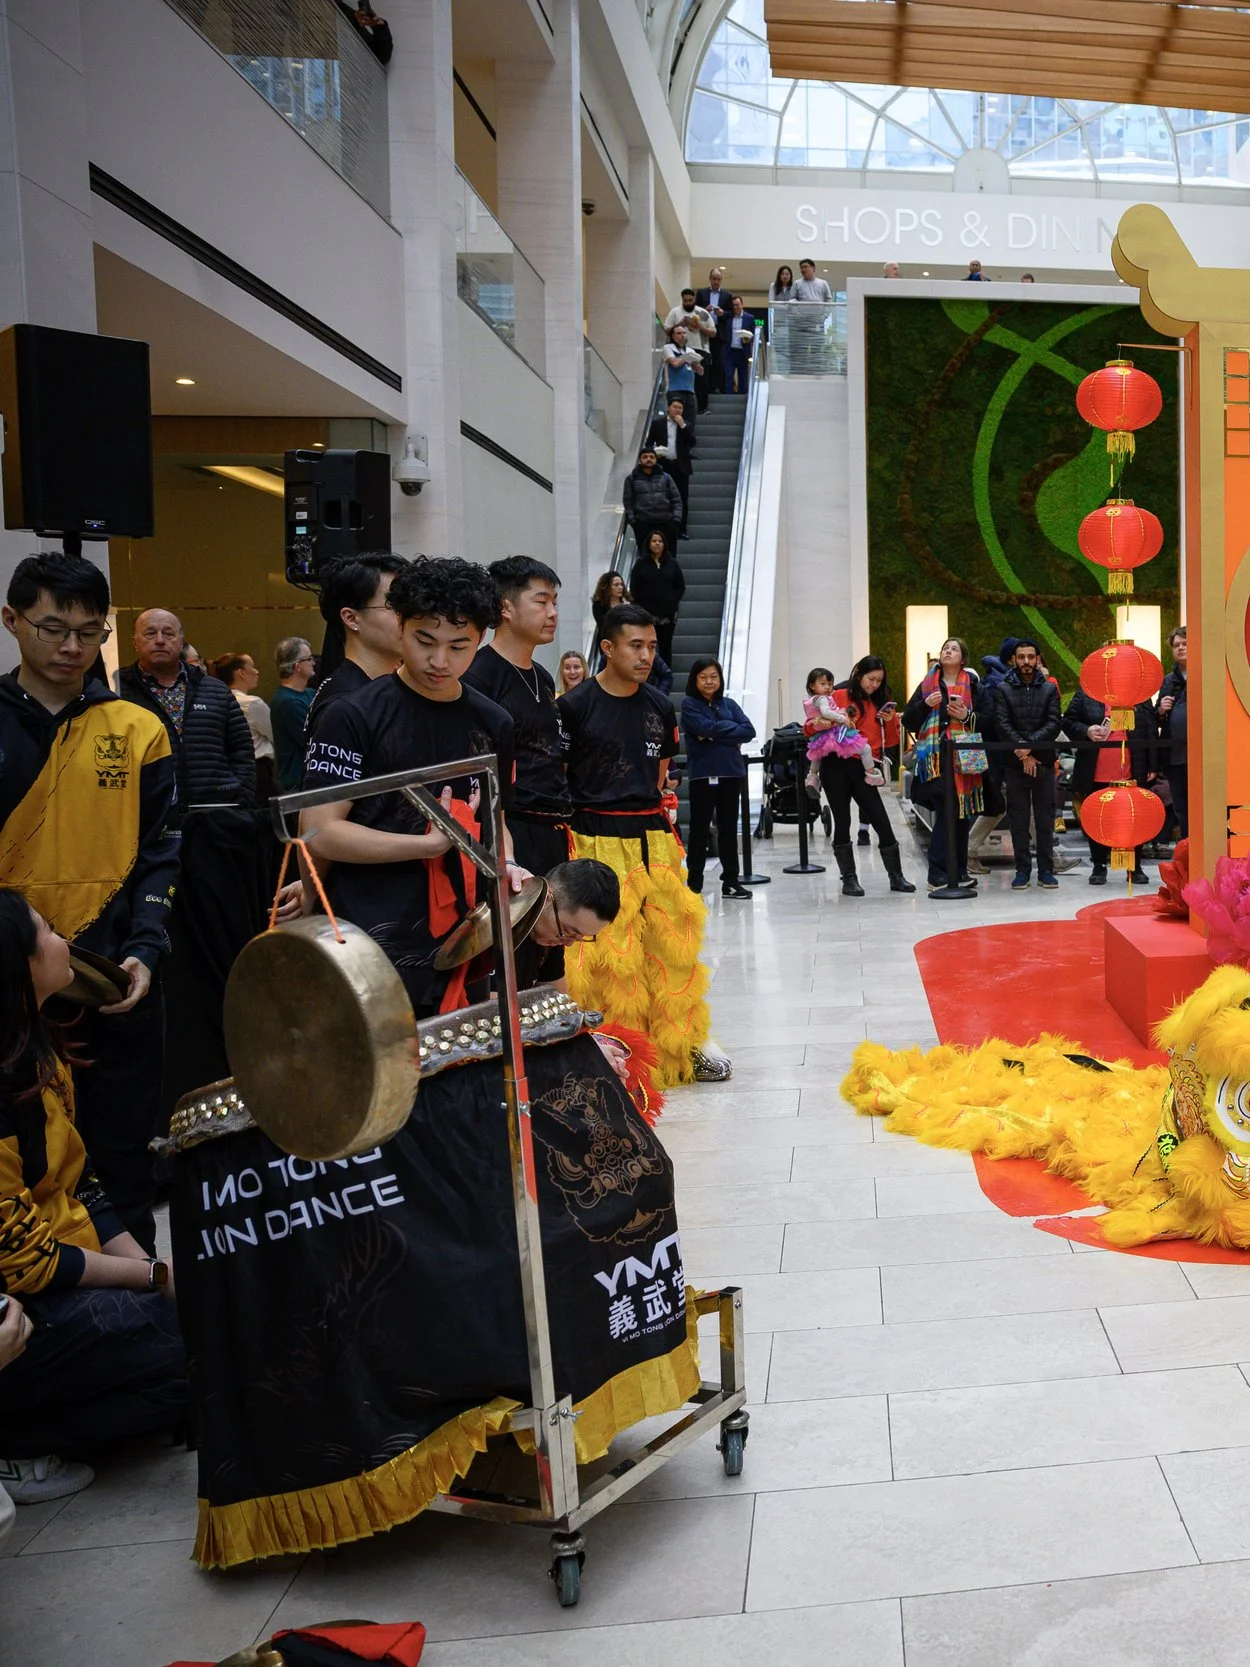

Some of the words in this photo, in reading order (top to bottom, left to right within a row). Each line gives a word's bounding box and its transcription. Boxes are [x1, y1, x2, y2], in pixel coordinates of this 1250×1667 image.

[796, 204, 943, 246] SHOPS
[960, 210, 990, 248] &
[1008, 212, 1116, 253] DININ
[319, 743, 363, 765] TONG
[645, 741, 662, 750] YM
[95, 770, 130, 779] YMT
[308, 759, 362, 781] DANCE
[265, 1173, 405, 1241] DANCE
[641, 1322, 664, 1335] TONG
